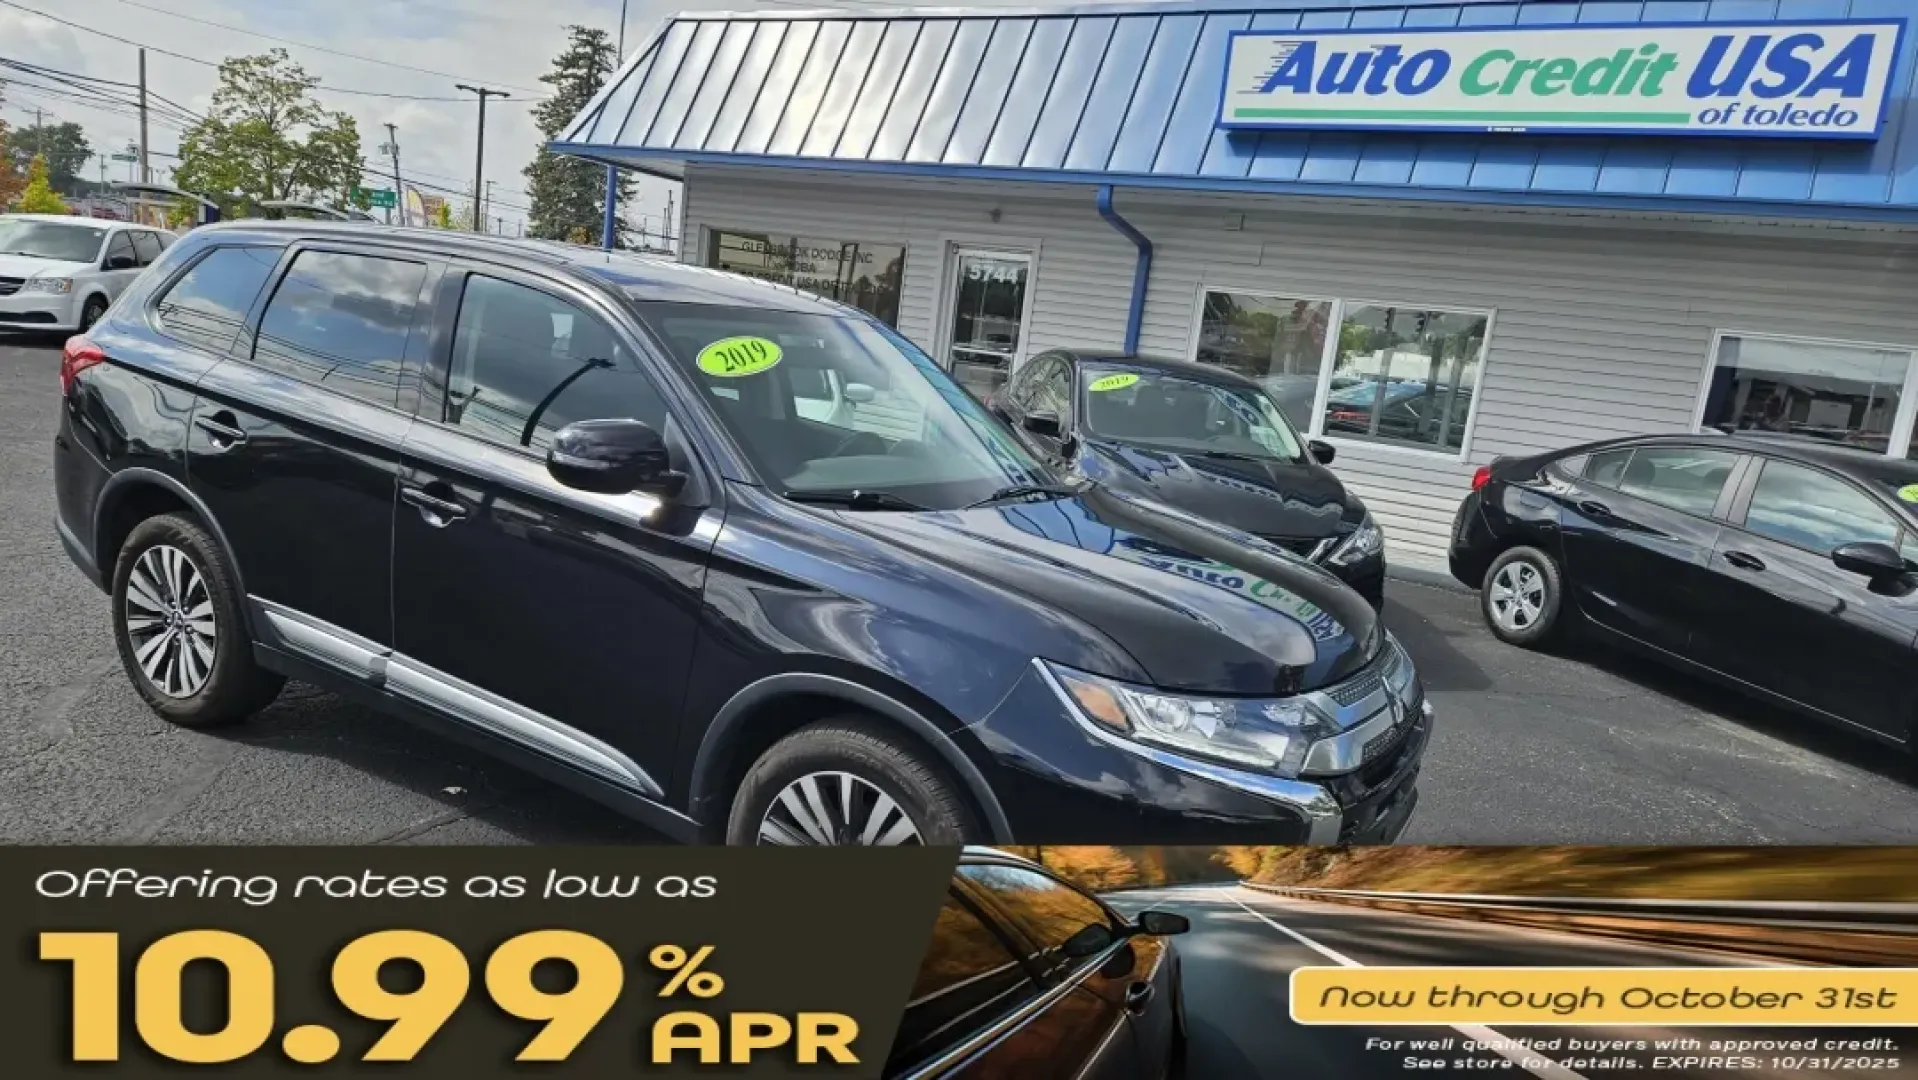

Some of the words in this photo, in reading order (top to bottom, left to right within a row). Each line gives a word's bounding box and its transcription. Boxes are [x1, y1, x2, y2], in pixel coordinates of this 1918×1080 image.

[1252, 40, 1451, 95] Auto
[1459, 42, 1679, 97] Credit
[1686, 33, 1876, 98] USA
[1698, 102, 1740, 124] of
[1742, 102, 1858, 127] toledo
[969, 264, 1018, 284] 5744
[715, 340, 767, 372] 2019
